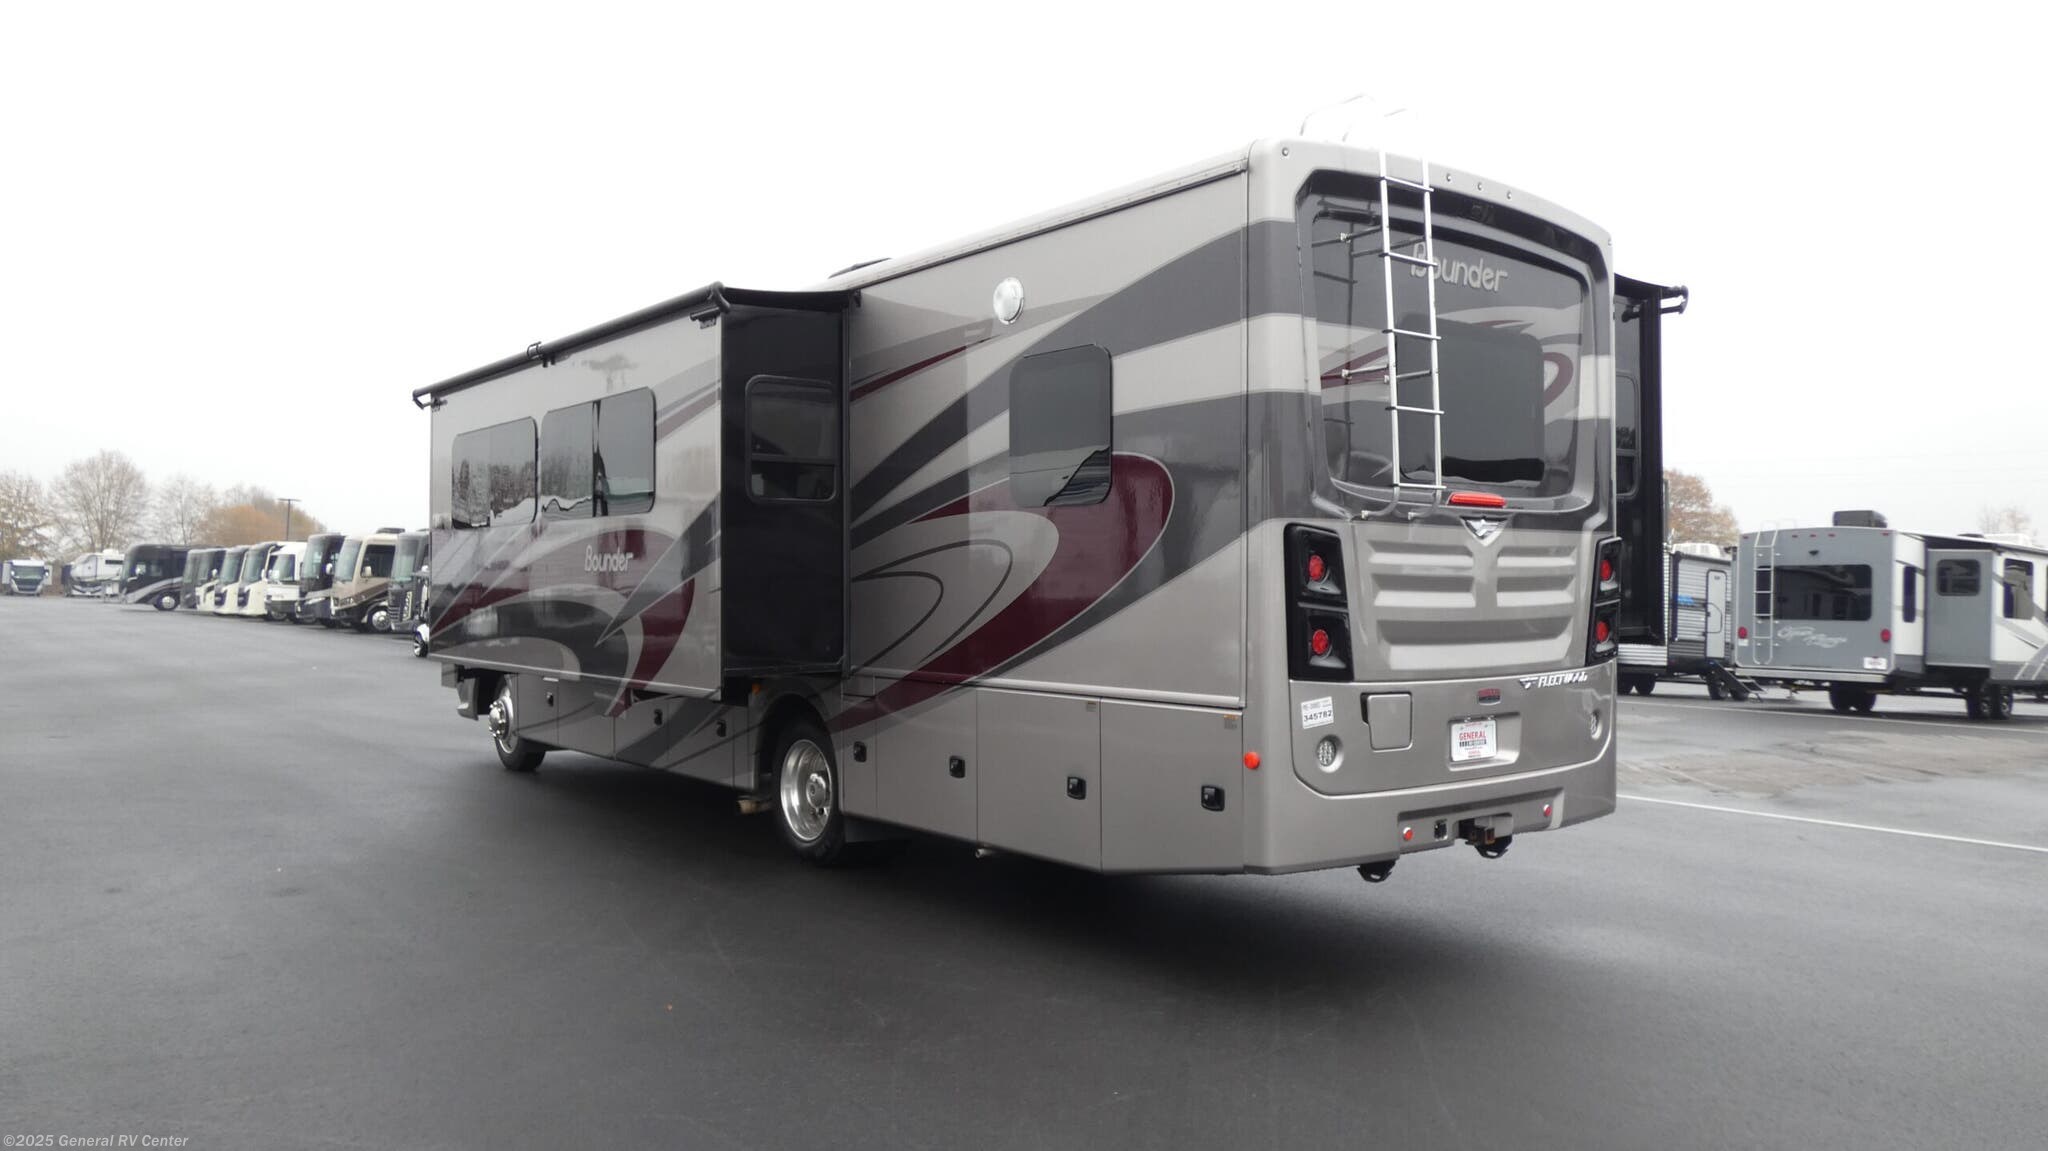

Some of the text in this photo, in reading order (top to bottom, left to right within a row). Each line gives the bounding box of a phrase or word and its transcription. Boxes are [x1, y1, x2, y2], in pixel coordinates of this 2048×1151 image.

[584, 545, 634, 572] Bounder
[1303, 709, 1332, 722] 345782
[1459, 730, 1487, 741] GENERAL
